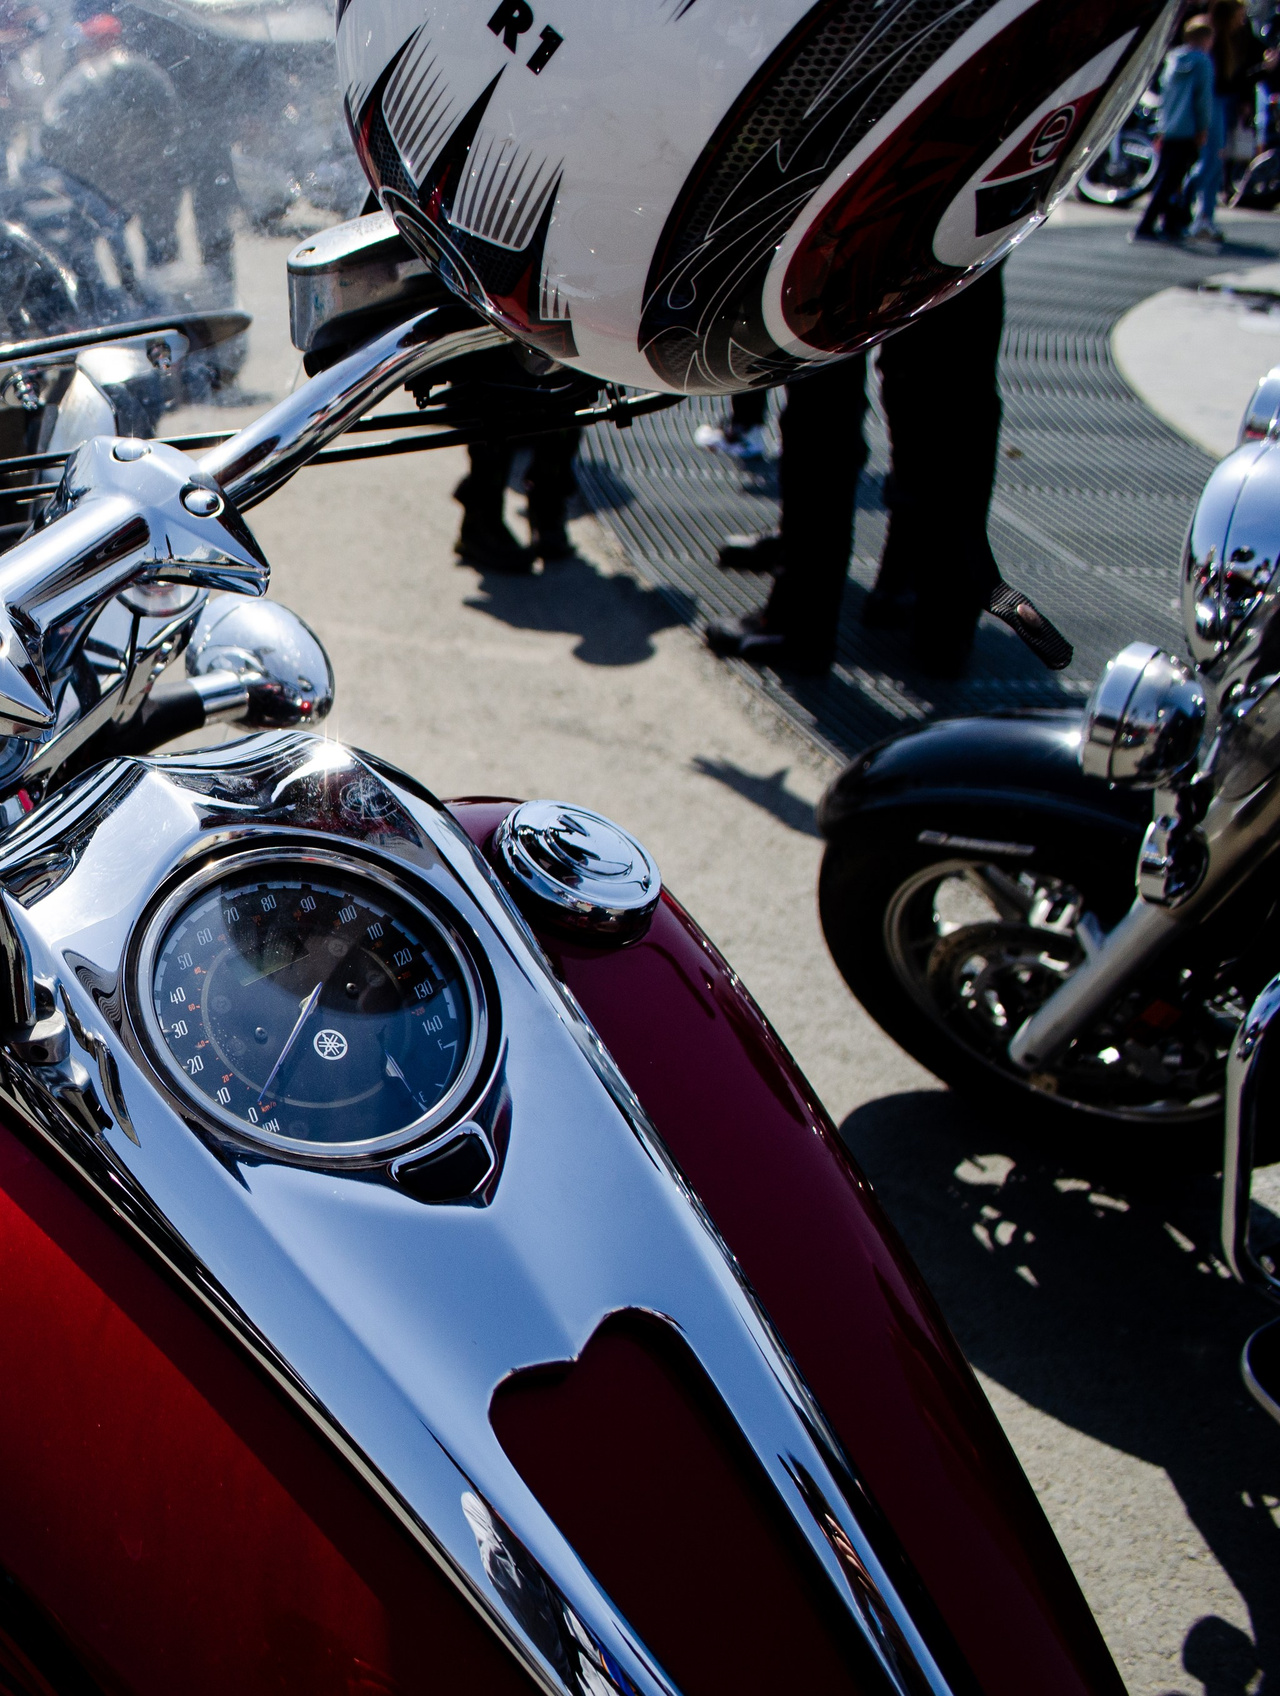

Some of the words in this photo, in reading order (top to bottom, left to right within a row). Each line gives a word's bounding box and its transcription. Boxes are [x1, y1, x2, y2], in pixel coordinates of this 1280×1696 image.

[486, 0, 565, 76] R1
[261, 894, 277, 912] 80
[300, 895, 317, 913] 90
[223, 906, 240, 924] 70
[338, 904, 358, 924] 100
[196, 927, 213, 946] 60
[367, 922, 384, 941] 110
[177, 952, 193, 971] 50
[393, 947, 413, 967] 120
[169, 986, 186, 1005] 40
[414, 979, 434, 1000] 130
[171, 1020, 188, 1039] 30
[422, 1015, 443, 1036] 140
[437, 1039, 443, 1051] F
[186, 1055, 205, 1075] 20
[216, 1087, 231, 1106] 10
[247, 1106, 259, 1123] 0
[262, 1117, 280, 1132] PH
